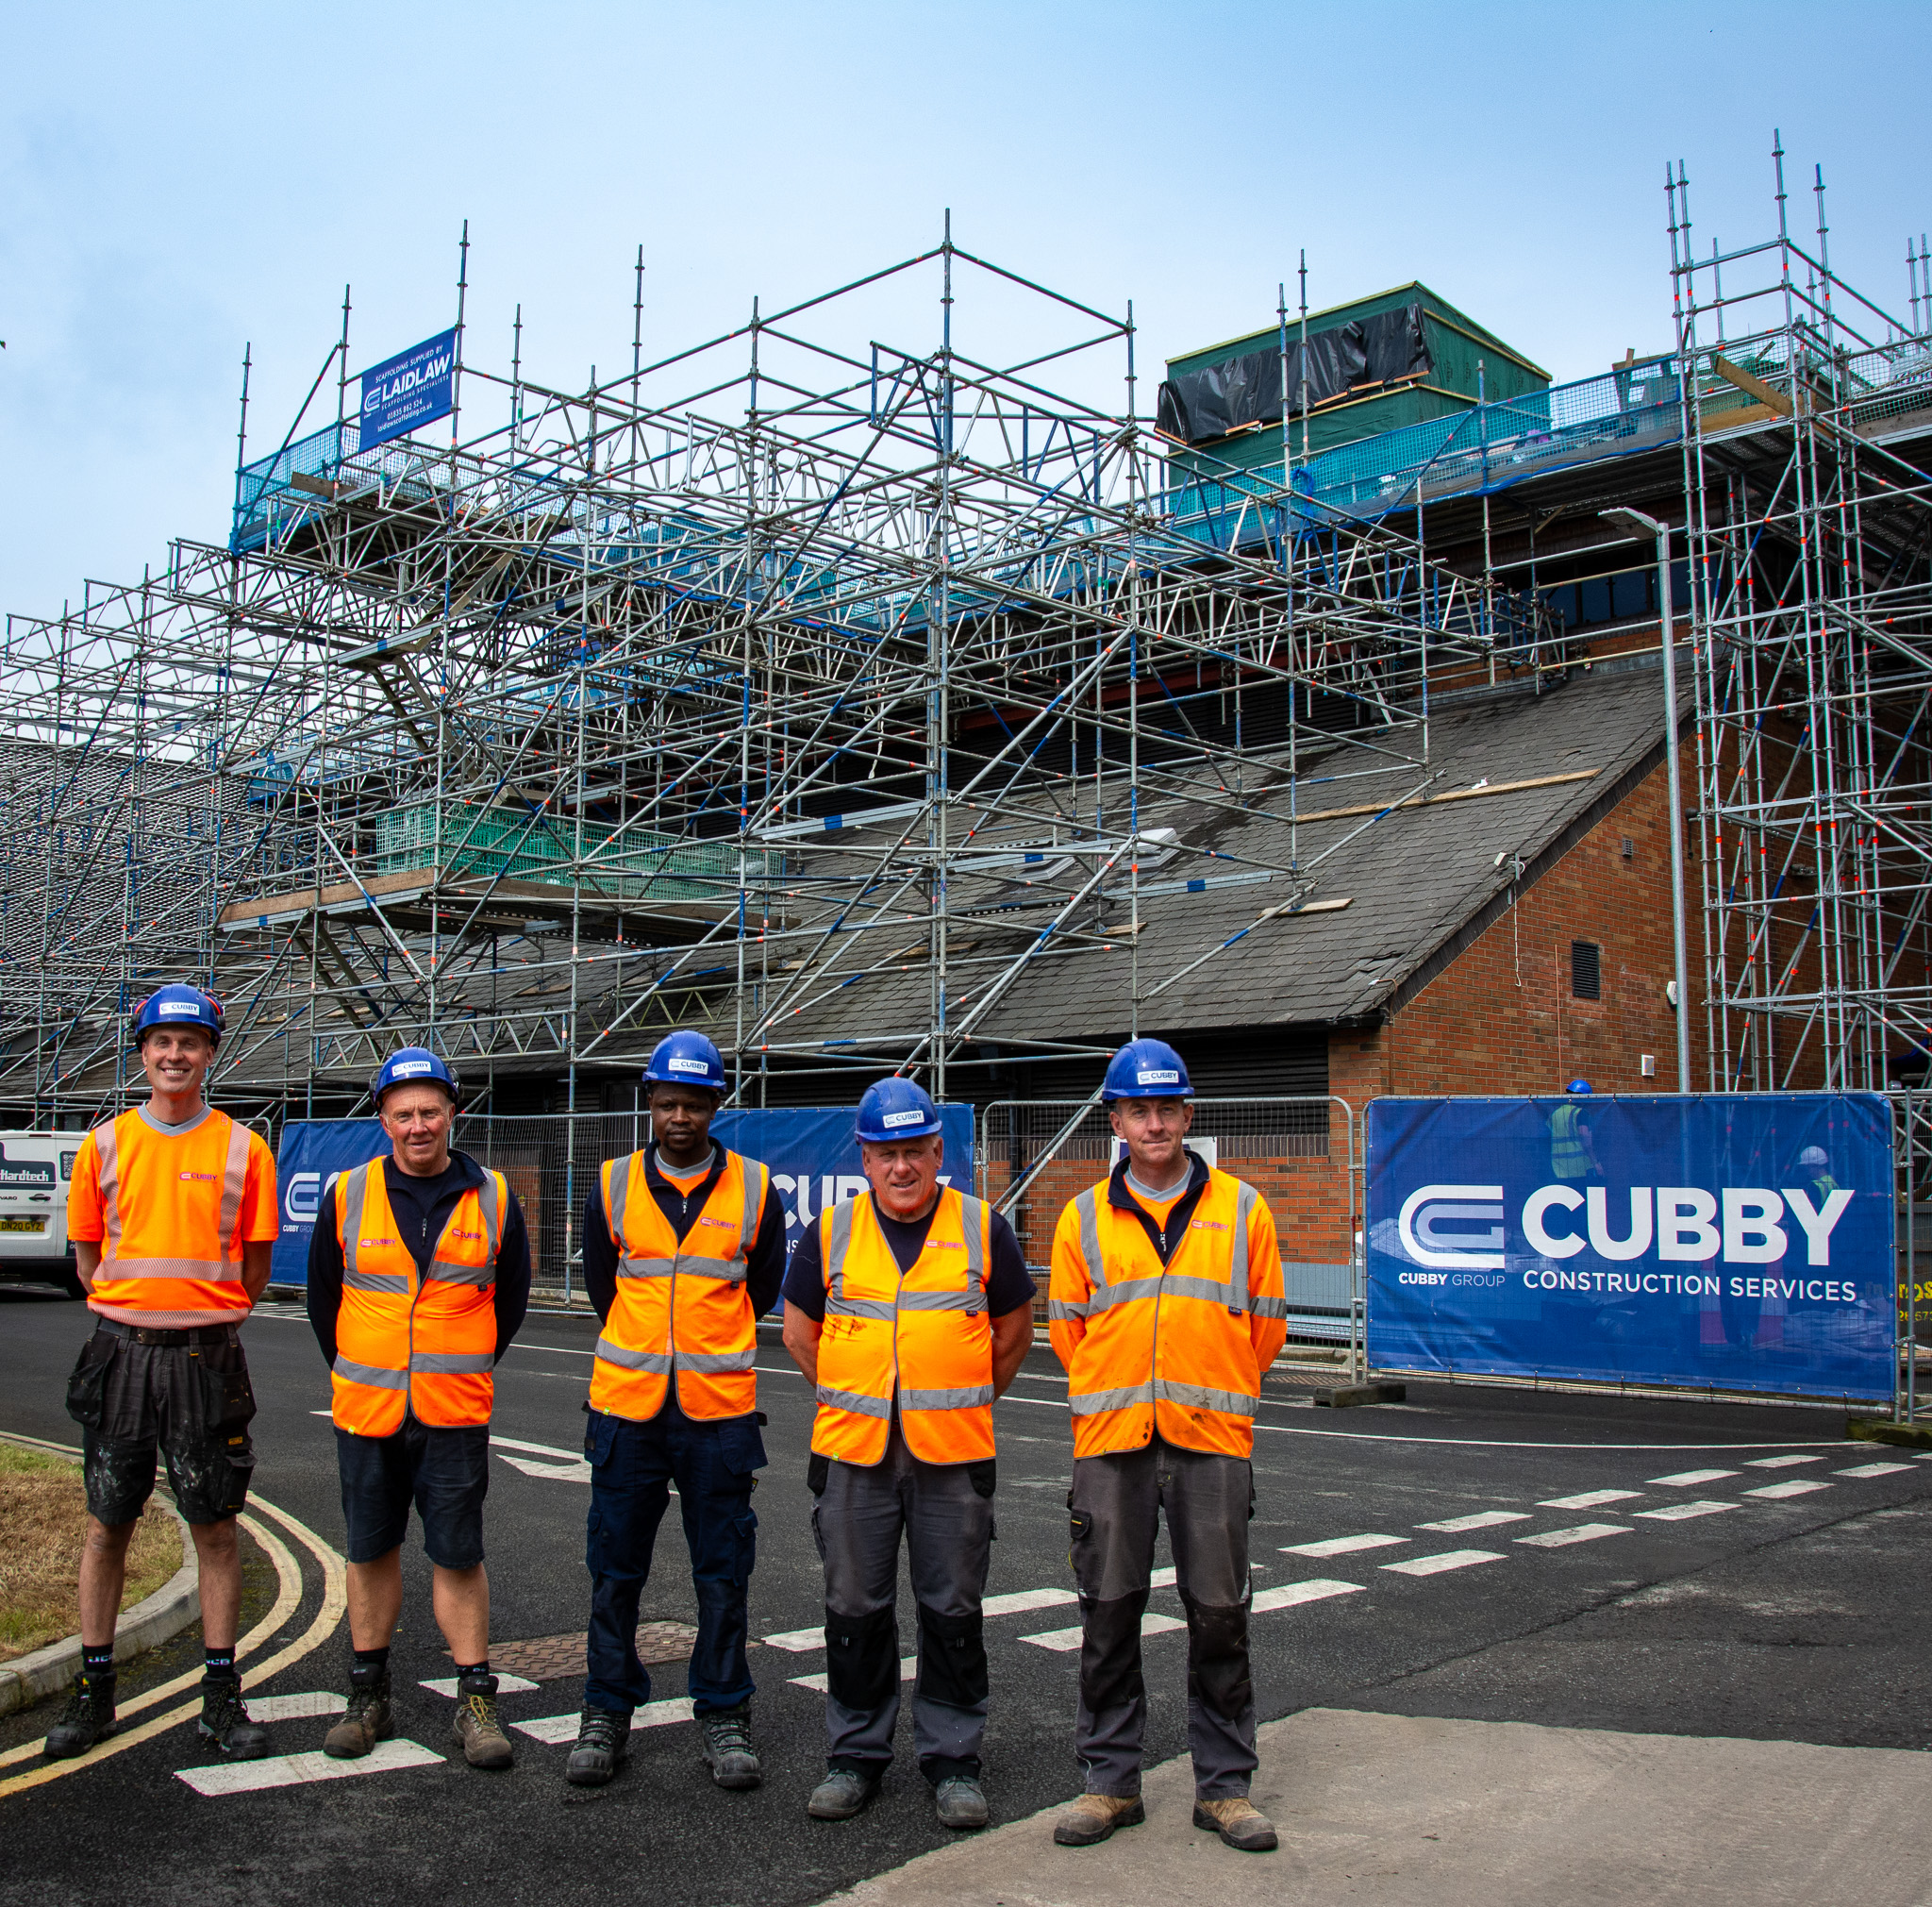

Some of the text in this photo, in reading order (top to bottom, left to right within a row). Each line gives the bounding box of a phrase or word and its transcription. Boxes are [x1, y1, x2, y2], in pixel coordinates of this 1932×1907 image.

[375, 344, 443, 384] SCAFFOLDING SUPPLIED BY
[382, 353, 452, 403] LAIDLAW
[381, 374, 450, 410] SCAFFOLDING SPECIALISTS
[681, 1061, 707, 1070] CUBBY
[896, 1112, 922, 1121] CUBBY
[191, 1172, 218, 1181] CUBBY
[2, 1221, 42, 1230] DN20 GYZ
[711, 1218, 736, 1230] CUBBY
[1203, 1221, 1229, 1230] CUBBY
[1522, 1184, 1856, 1266] CUBBY
[460, 1231, 482, 1240] CUBBY
[938, 1241, 964, 1249] CUBBY
[1398, 1272, 1506, 1287] CUBBY GROUP
[1523, 1269, 1857, 1302] CONSTRUCTION SERVICES
